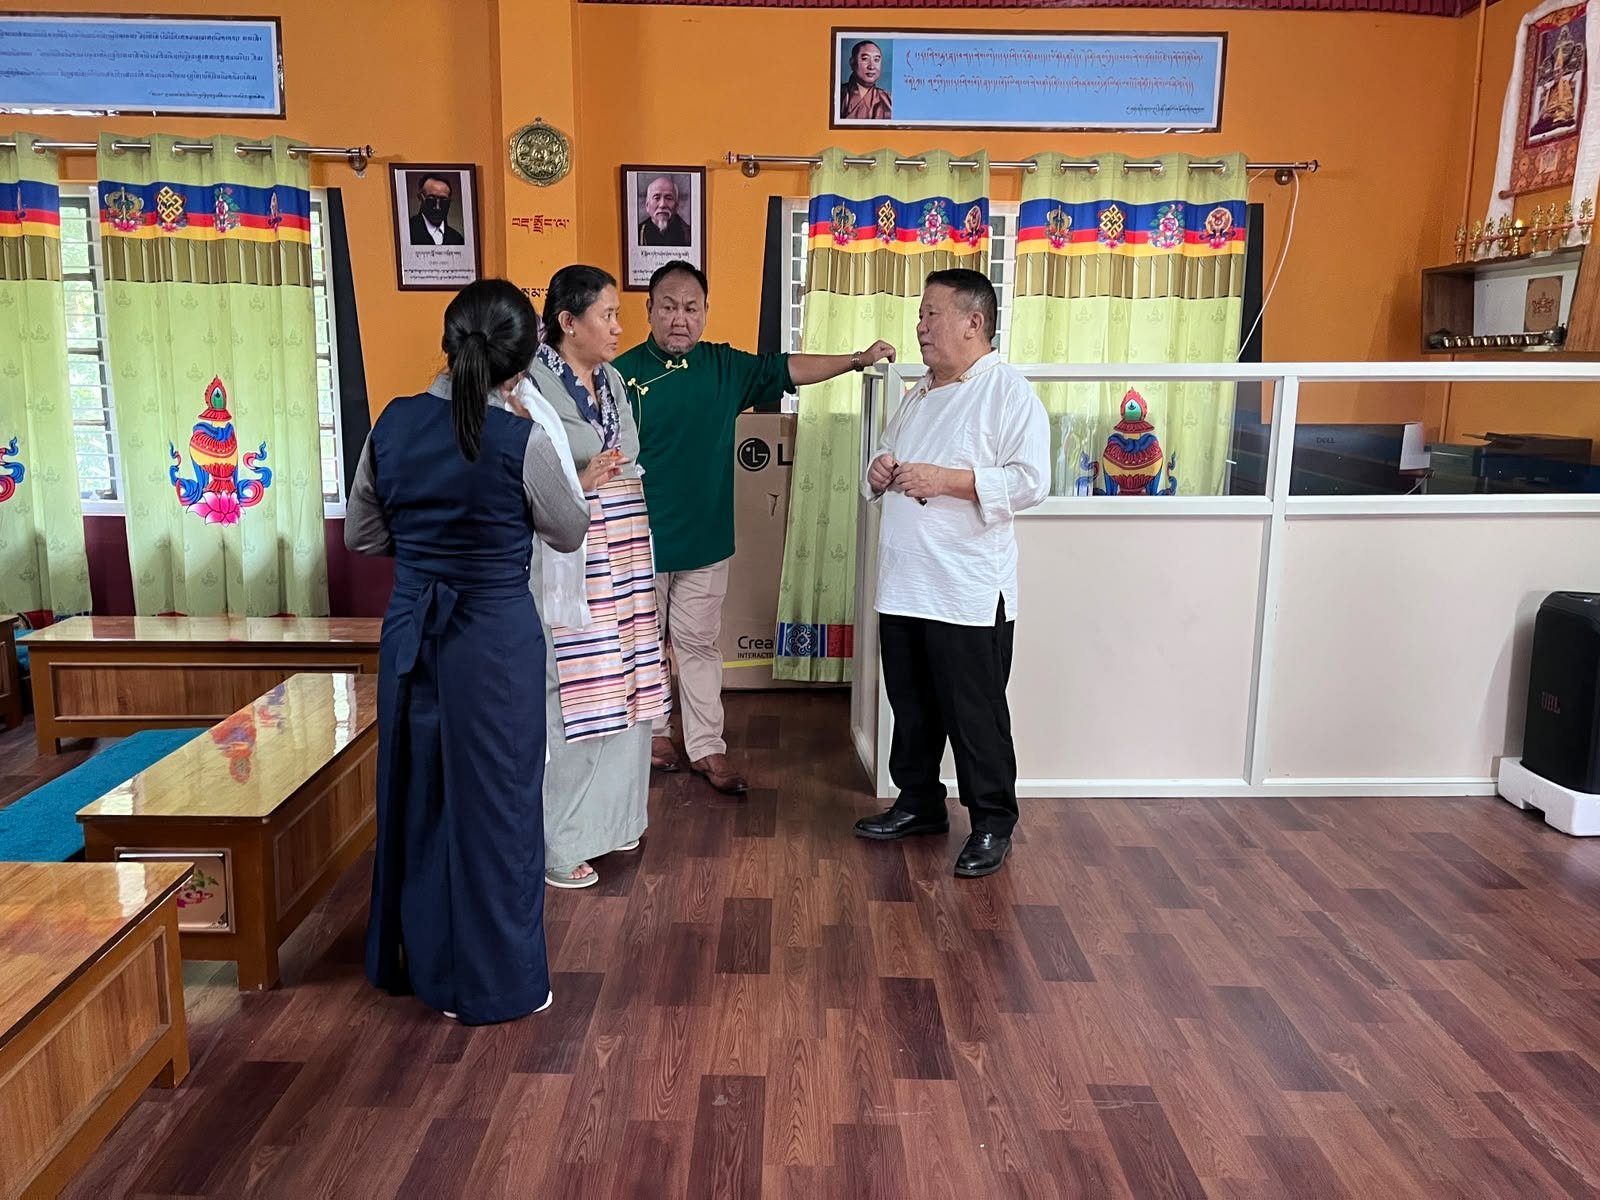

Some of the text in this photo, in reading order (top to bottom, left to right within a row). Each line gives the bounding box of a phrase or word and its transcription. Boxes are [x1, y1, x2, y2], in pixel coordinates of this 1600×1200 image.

[1316, 436, 1336, 444] DELL
[738, 438, 793, 471] LG L
[738, 635, 774, 650] Crea
[1541, 691, 1561, 715] JBL
